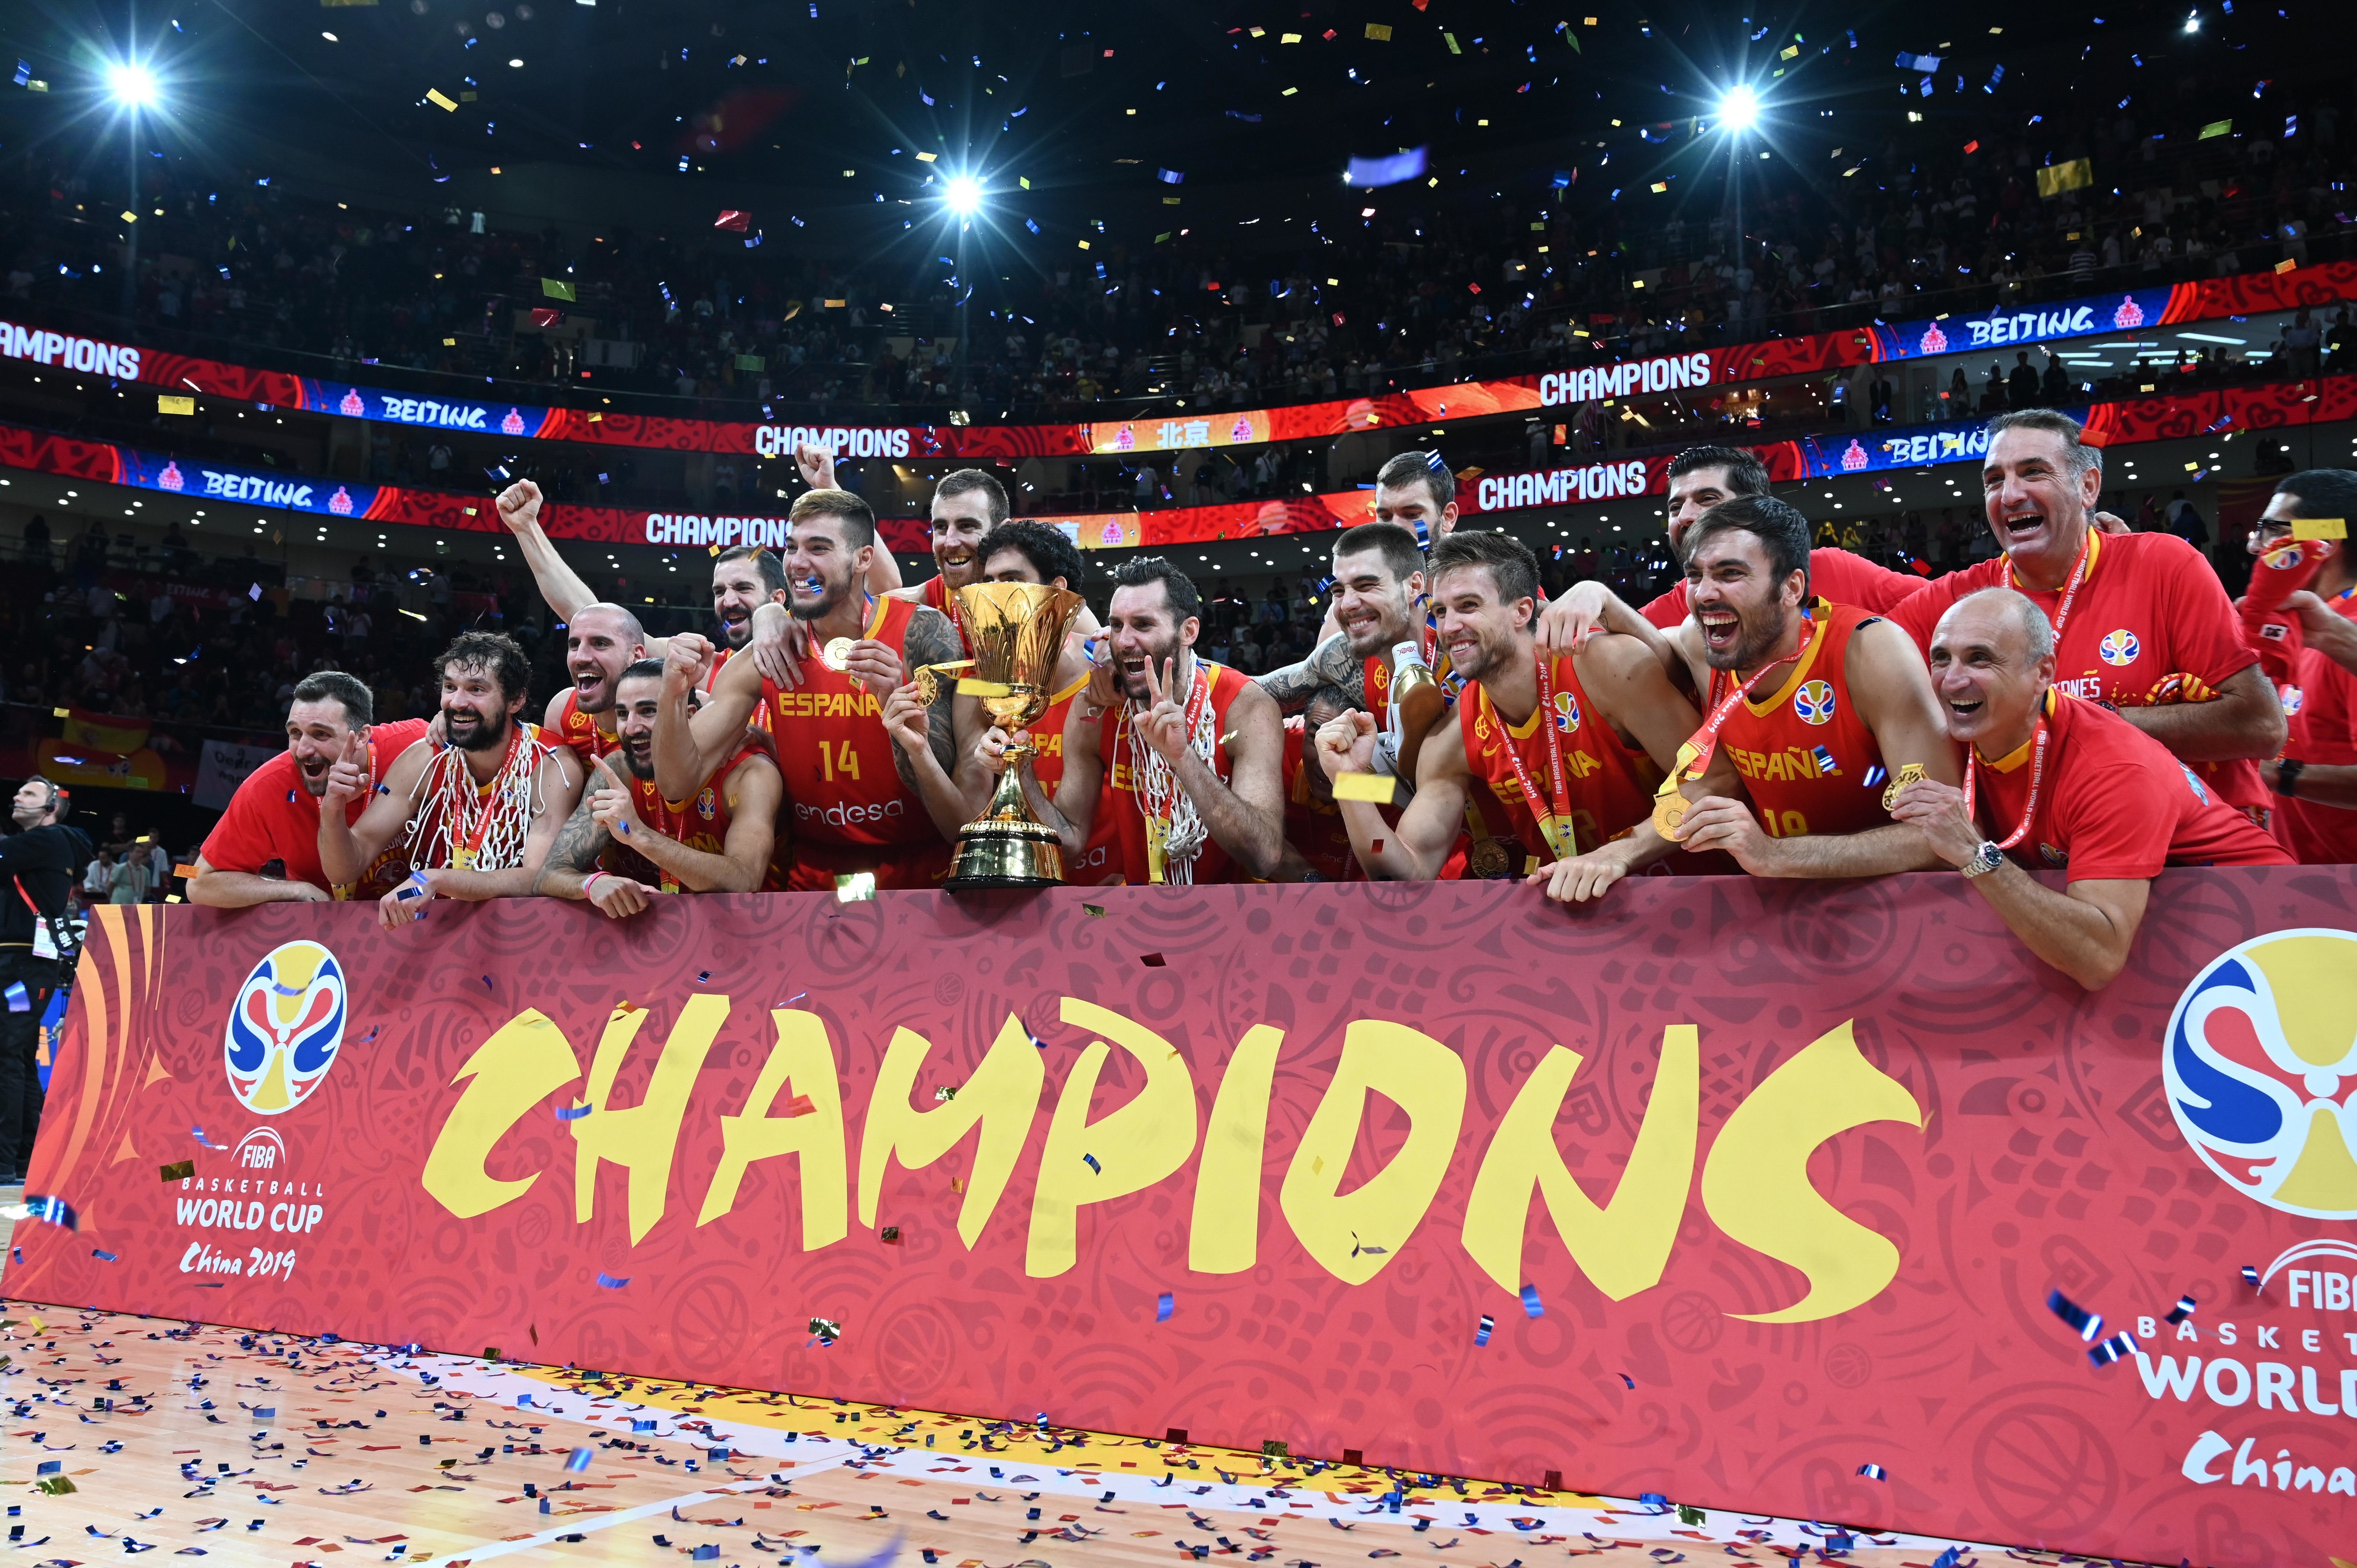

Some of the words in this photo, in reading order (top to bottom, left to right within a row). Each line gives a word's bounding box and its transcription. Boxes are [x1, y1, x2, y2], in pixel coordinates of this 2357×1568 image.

[1540, 353, 1710, 406] CHAMPIONS
[755, 426, 910, 458] CHAMPIONS
[1157, 420, 1210, 449] 北京
[1886, 428, 1989, 463] BEIJIN
[1479, 461, 1647, 510] CHAMPIONS
[646, 514, 792, 547] CHAMPION
[2060, 593, 2073, 616] WORLD
[2057, 616, 2065, 629] CUP
[1744, 680, 1754, 690] CUP
[1754, 664, 1773, 680] WORLD
[1187, 702, 1198, 724] China
[1193, 684, 1204, 701] 2019
[1542, 681, 1551, 707] China
[1722, 690, 1743, 713] China
[1548, 722, 1556, 744] WORLD
[1707, 713, 1725, 733] 2019
[2037, 730, 2047, 745] FIBA
[819, 741, 860, 781] 14
[1499, 726, 1509, 744] WORLD
[1512, 757, 1526, 780] China
[1523, 780, 1537, 798] 2019
[1550, 743, 1561, 780] BASKETBALL
[2032, 745, 2044, 788] BASKETBALL
[480, 798, 493, 824] BASKETBALL
[503, 753, 513, 773] China
[509, 739, 518, 754] 2019
[795, 799, 904, 825] endesa
[2026, 789, 2037, 813] WORLD
[241, 1145, 276, 1169] FIBA
[423, 994, 1922, 1323] CHAMPIONS
[182, 1177, 323, 1197] BASKETBALL
[177, 1197, 265, 1230] WORLD
[270, 1202, 323, 1233] CUP
[179, 1241, 242, 1275] China
[247, 1247, 296, 1282] 2019
[2289, 1269, 2357, 1312] FIB
[2182, 1430, 2356, 1497] China
